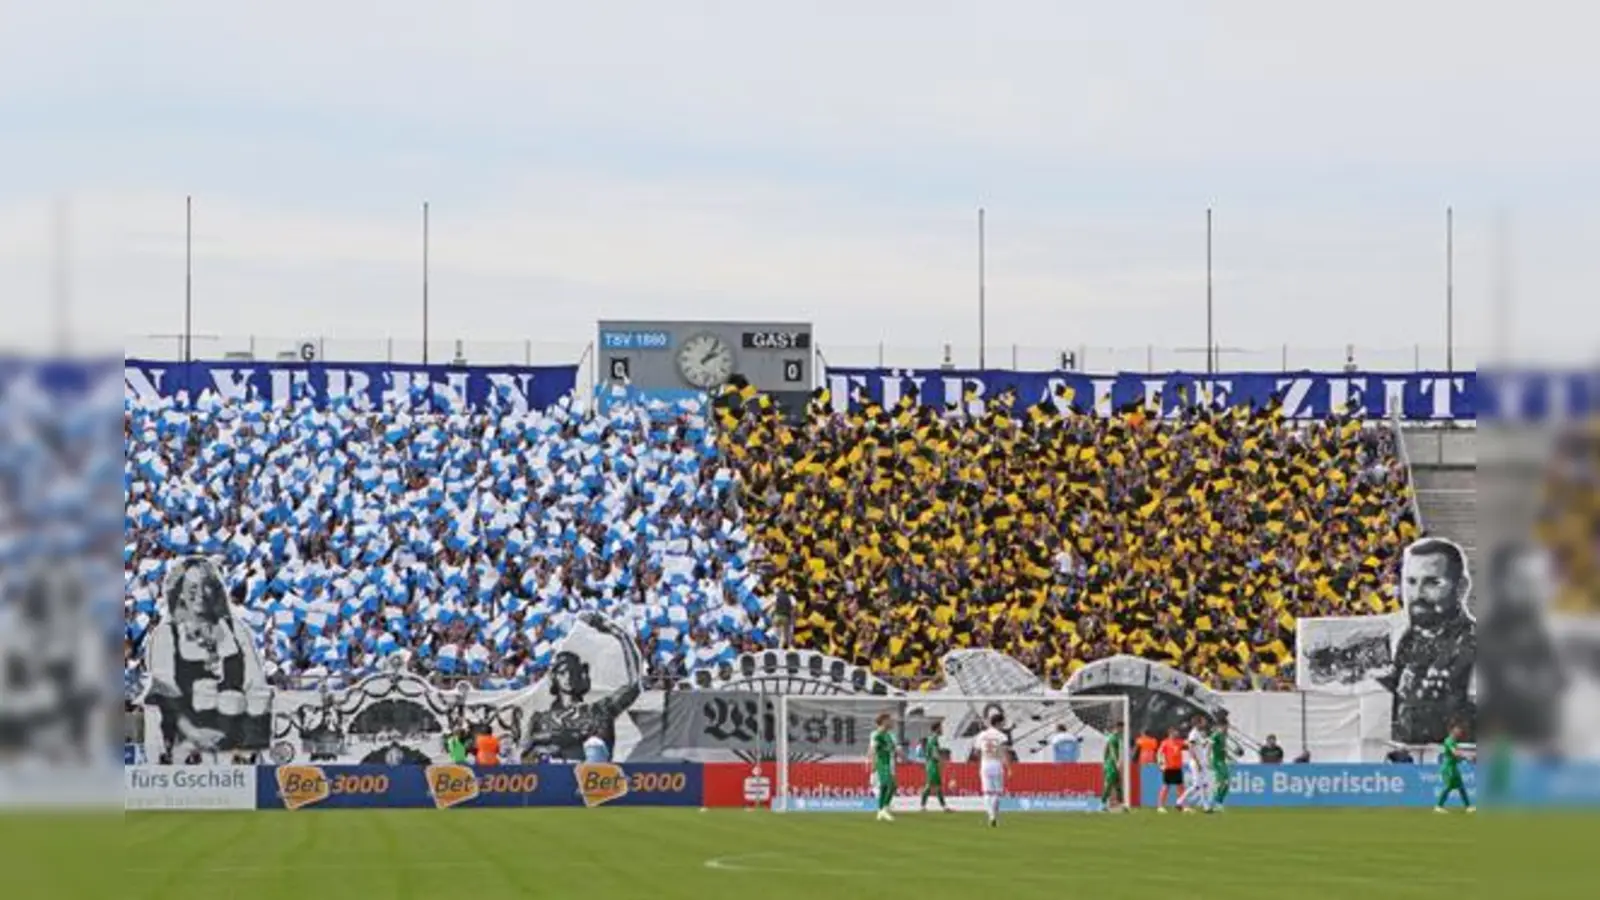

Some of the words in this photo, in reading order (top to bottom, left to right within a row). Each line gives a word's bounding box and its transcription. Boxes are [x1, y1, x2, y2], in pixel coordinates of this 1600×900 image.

[752, 332, 799, 348] GAST
[301, 342, 315, 360] G
[1062, 351, 1075, 370] H
[787, 363, 798, 380] 0
[1275, 378, 1465, 418] ZEIT
[1229, 771, 1266, 794] die
[1272, 771, 1405, 798] Bayerische
